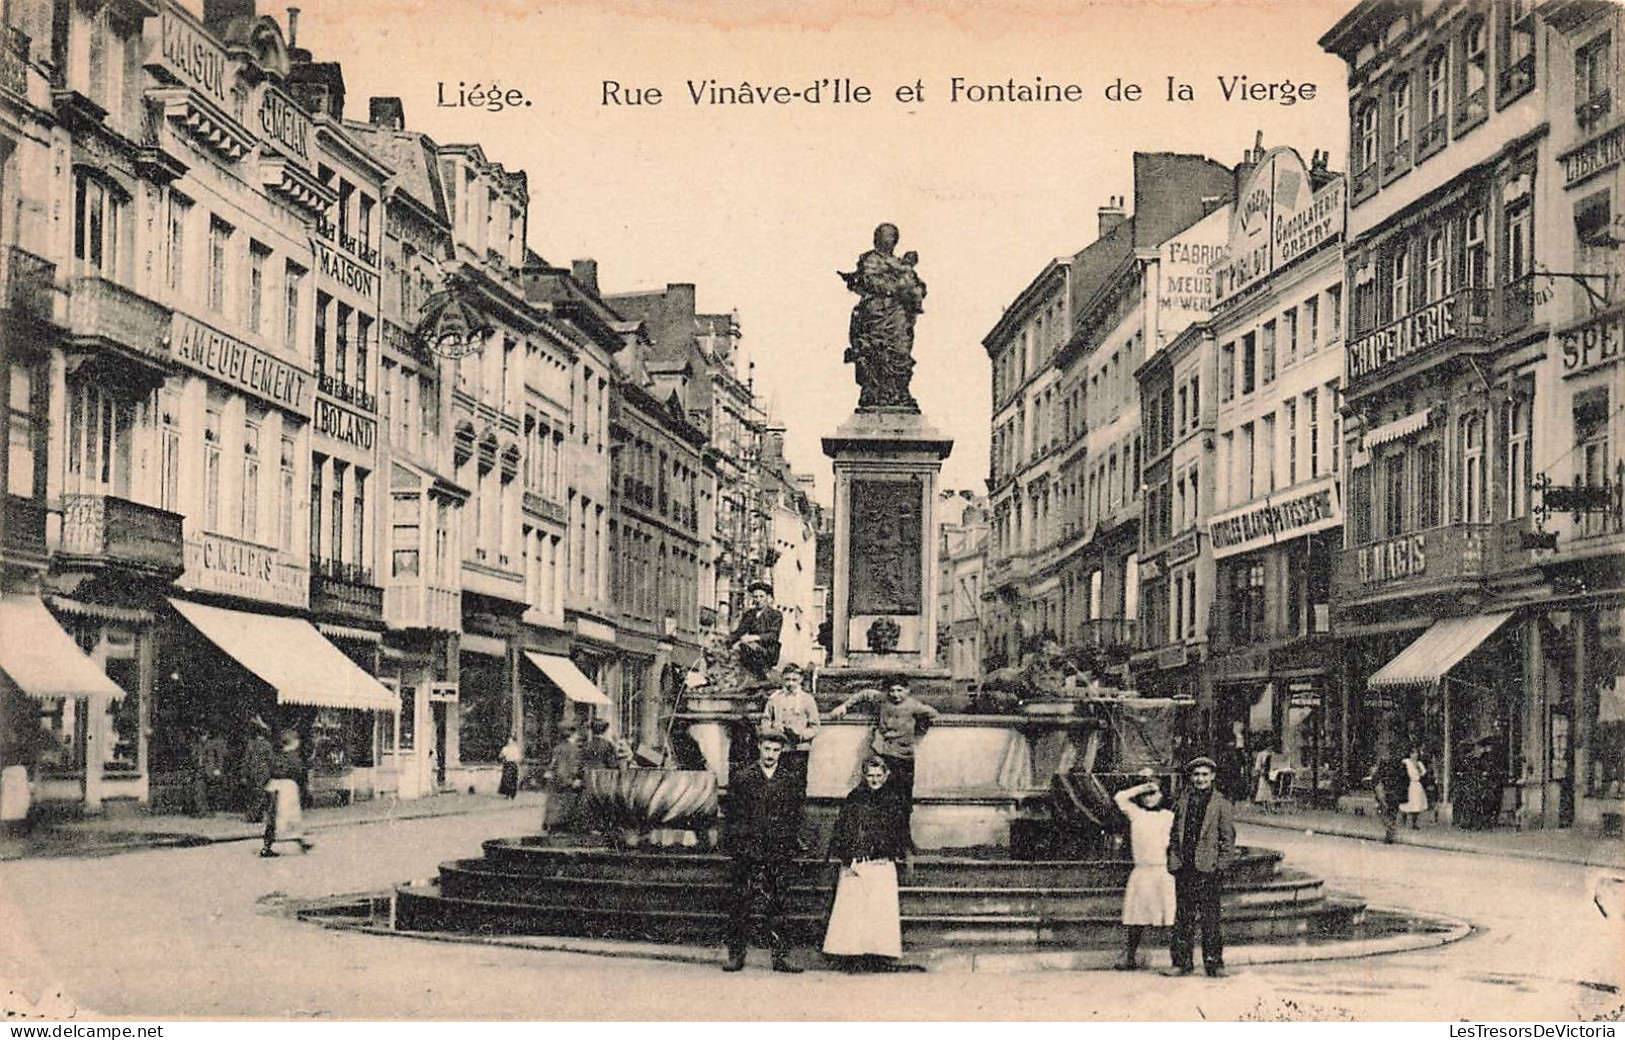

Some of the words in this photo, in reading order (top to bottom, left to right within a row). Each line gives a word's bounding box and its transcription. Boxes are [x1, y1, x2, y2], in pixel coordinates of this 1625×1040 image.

[1275, 189, 1340, 247] CHOCOLATERIE
[320, 245, 373, 298] MAISON
[178, 321, 306, 408] AMEUBLEMENT
[1349, 297, 1457, 379] CHAPELLERIE
